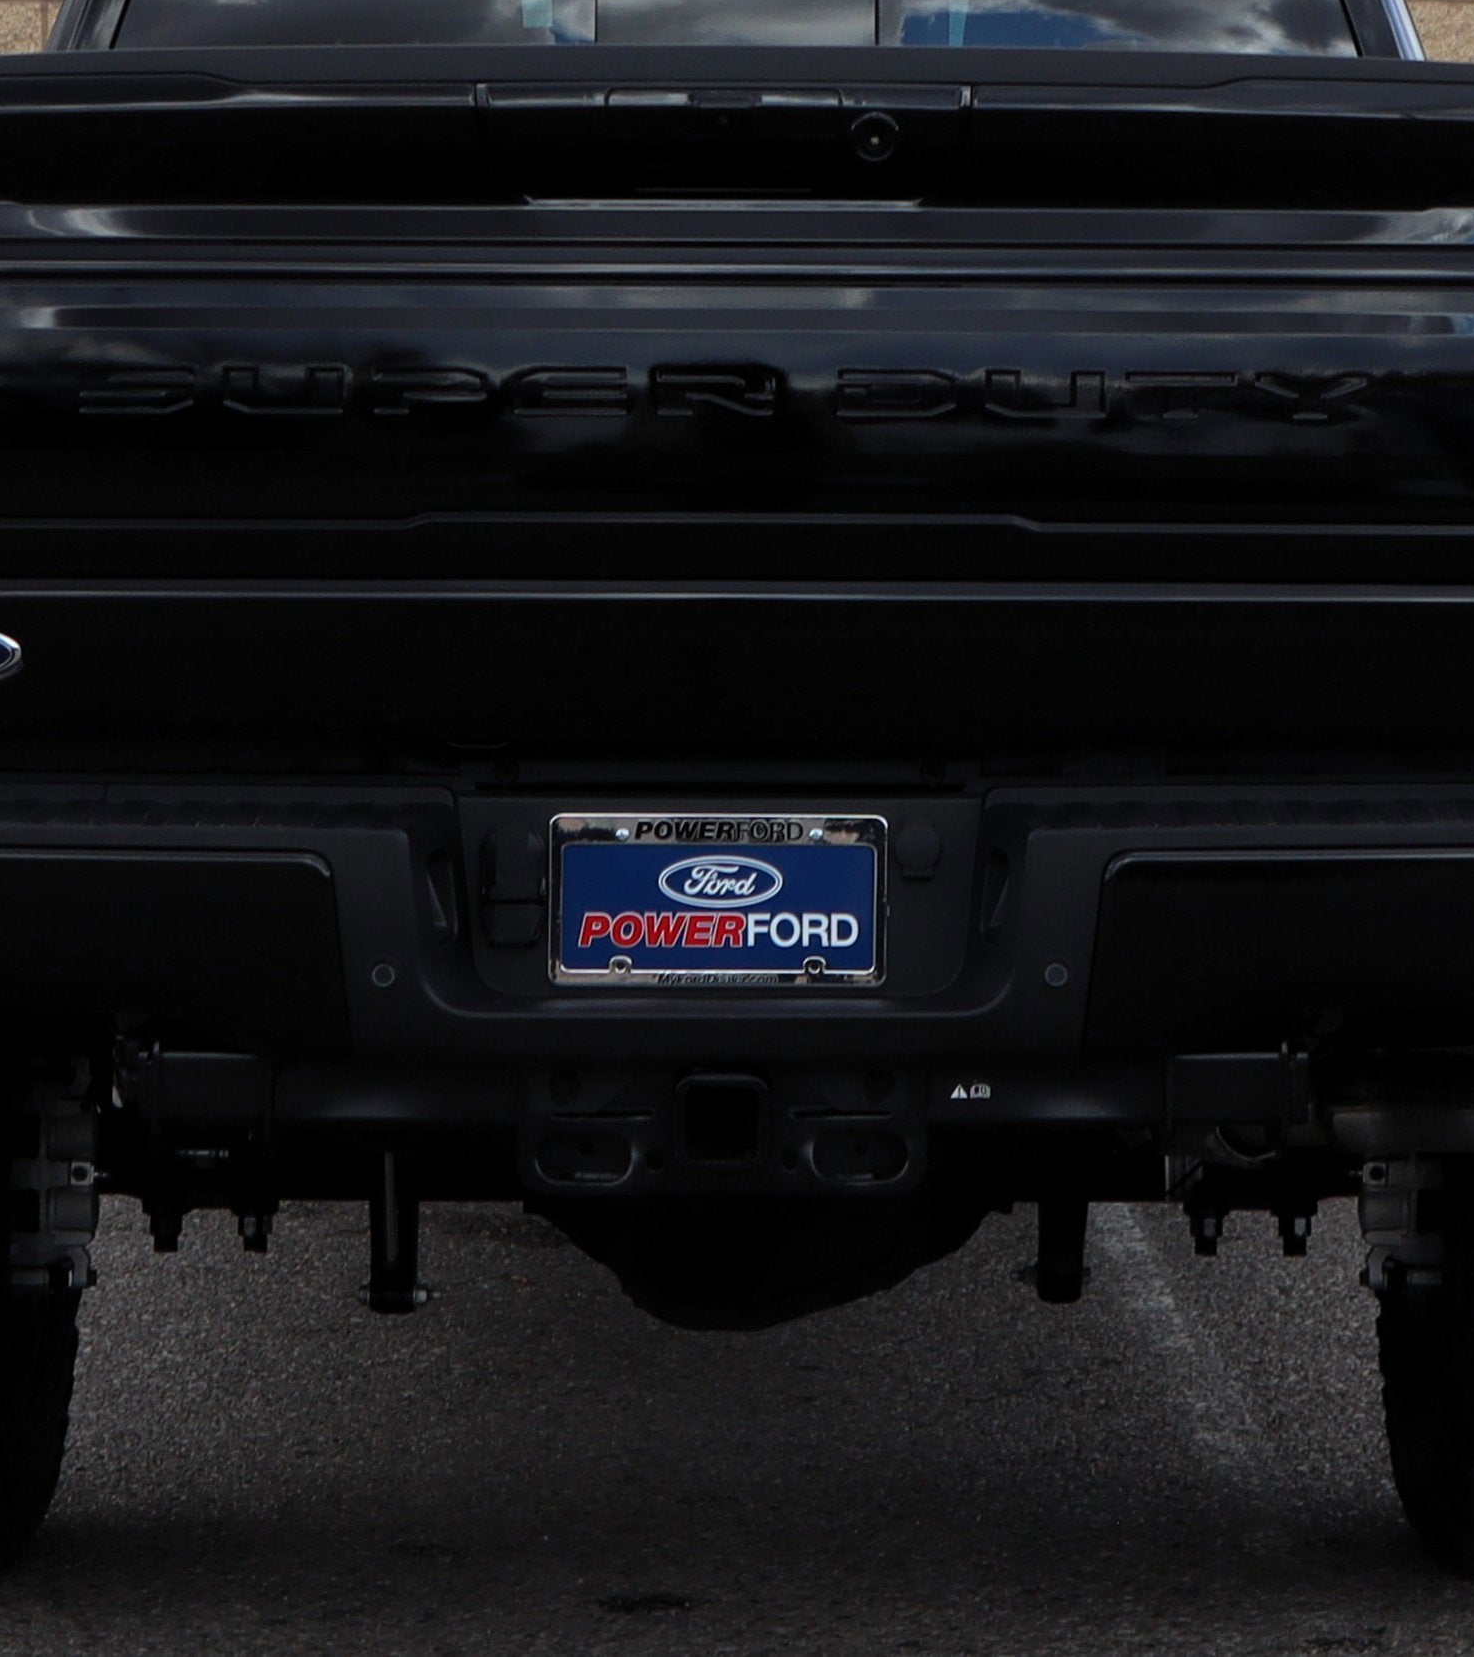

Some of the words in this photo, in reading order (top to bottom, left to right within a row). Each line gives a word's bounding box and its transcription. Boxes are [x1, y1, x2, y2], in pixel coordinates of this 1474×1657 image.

[79, 363, 783, 416] SUPER
[836, 368, 1369, 420] DUTY
[634, 819, 804, 843] POWERFORD
[683, 864, 757, 897] Ford
[579, 911, 859, 948] POWERFORD
